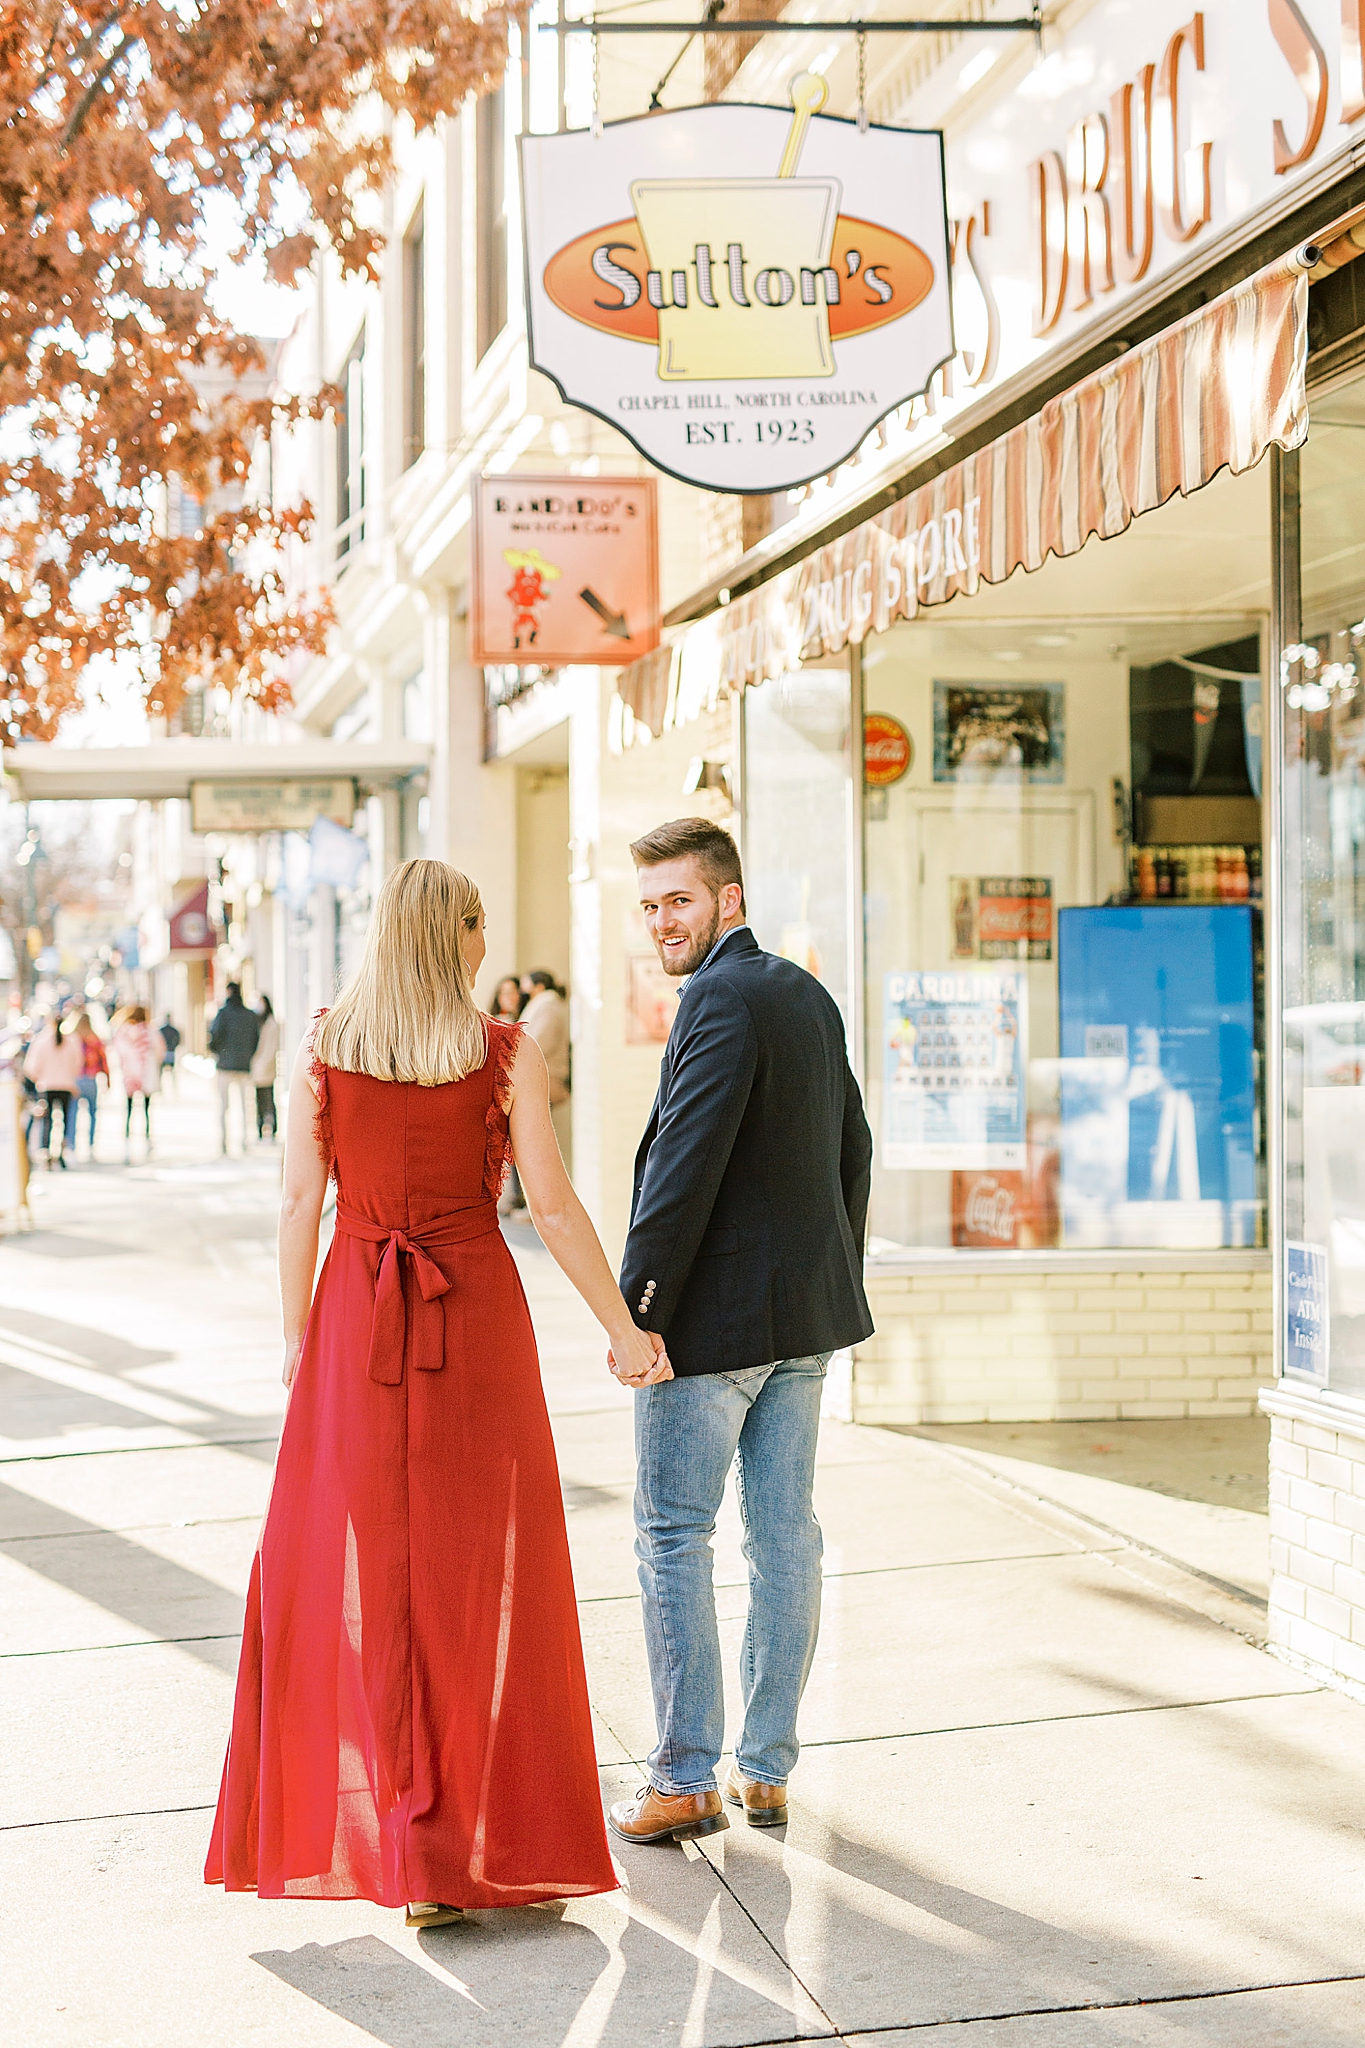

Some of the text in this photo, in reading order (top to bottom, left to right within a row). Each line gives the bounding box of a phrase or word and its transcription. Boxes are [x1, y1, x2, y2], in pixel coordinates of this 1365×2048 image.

[1027, 12, 1212, 340] DRUG
[590, 242, 894, 311] Sutton's
[618, 389, 878, 410] CHAPEL HILL, NORTH CAROLINA
[685, 419, 815, 445] EST. 1923
[883, 495, 981, 609] STORE
[1297, 1299, 1321, 1322] ATM
